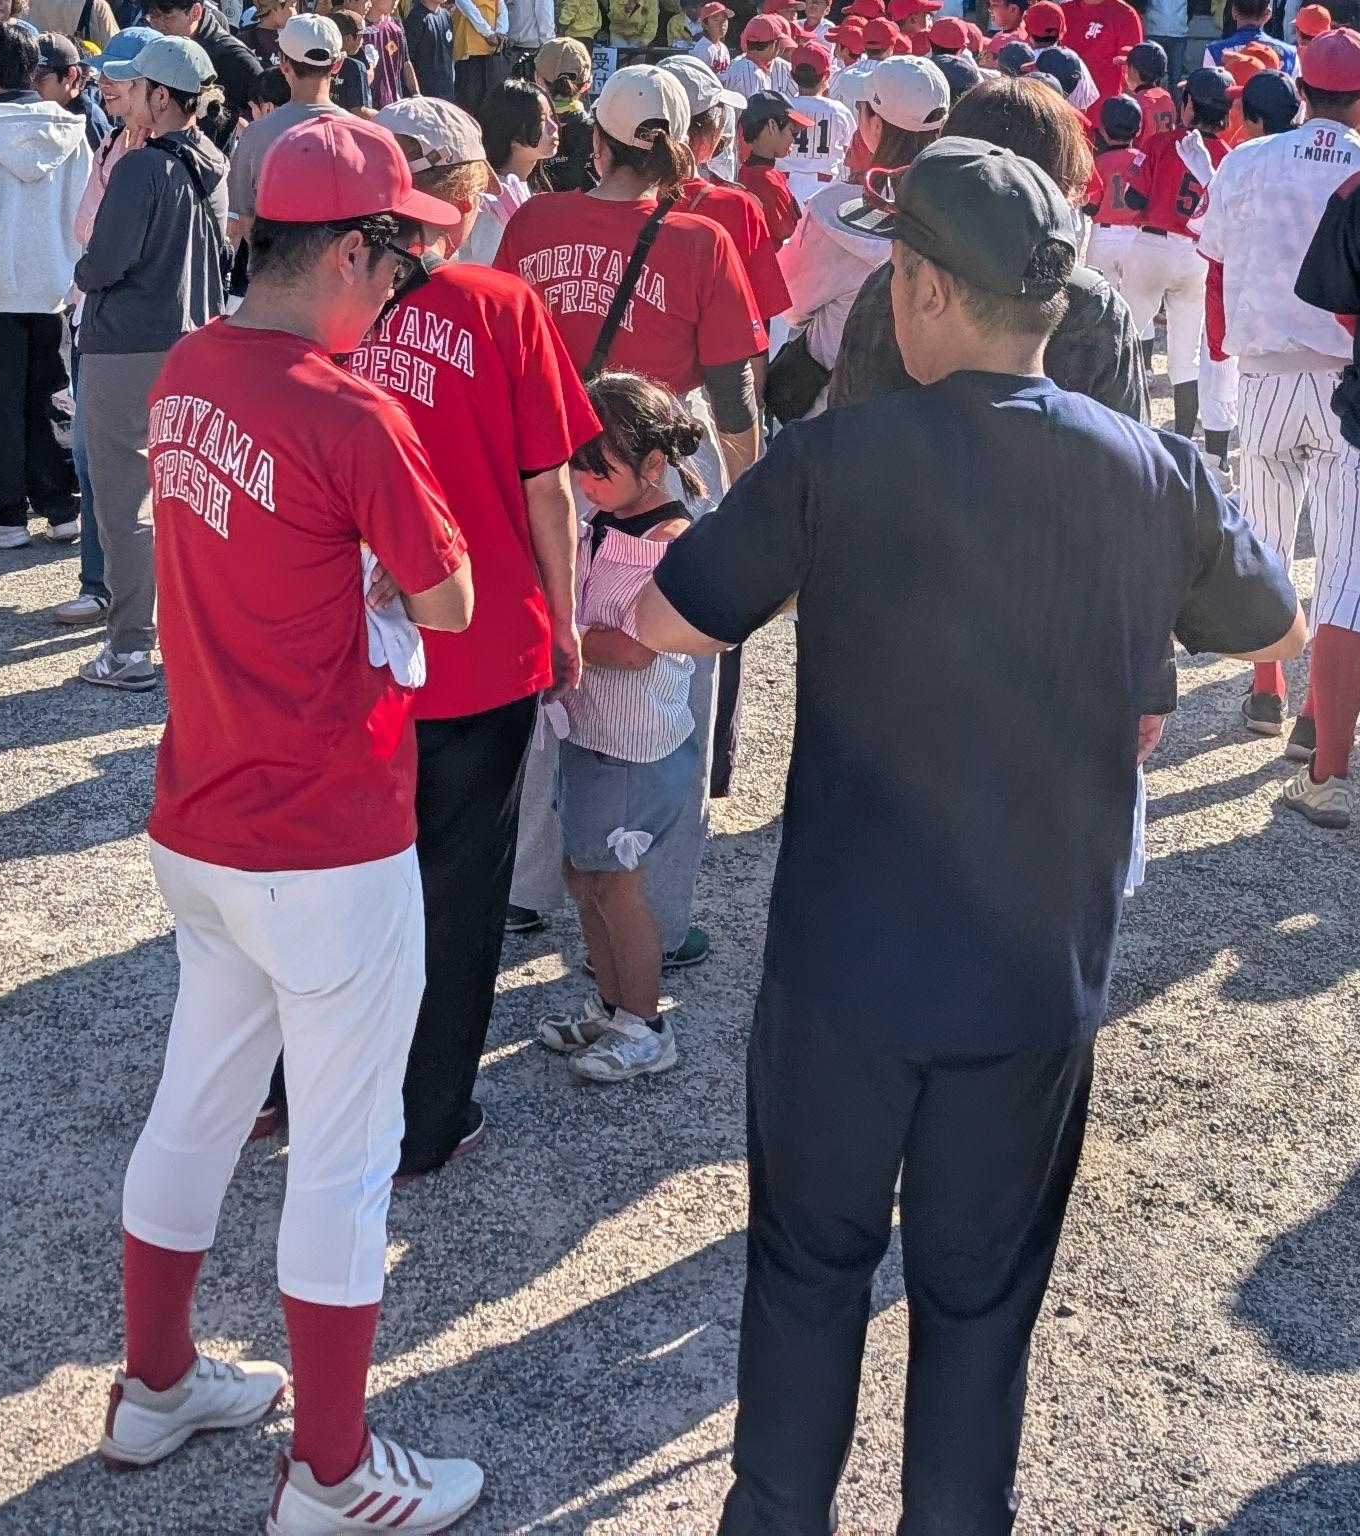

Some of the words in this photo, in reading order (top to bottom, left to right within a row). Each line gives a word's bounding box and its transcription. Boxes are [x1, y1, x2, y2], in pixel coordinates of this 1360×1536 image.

[1292, 144, 1352, 165] T.MORITA
[1313, 129, 1337, 148] 30
[362, 303, 475, 379] YAMA
[348, 345, 437, 409] RESH
[148, 394, 276, 513] ORIYAMA
[153, 449, 232, 540] FRESH
